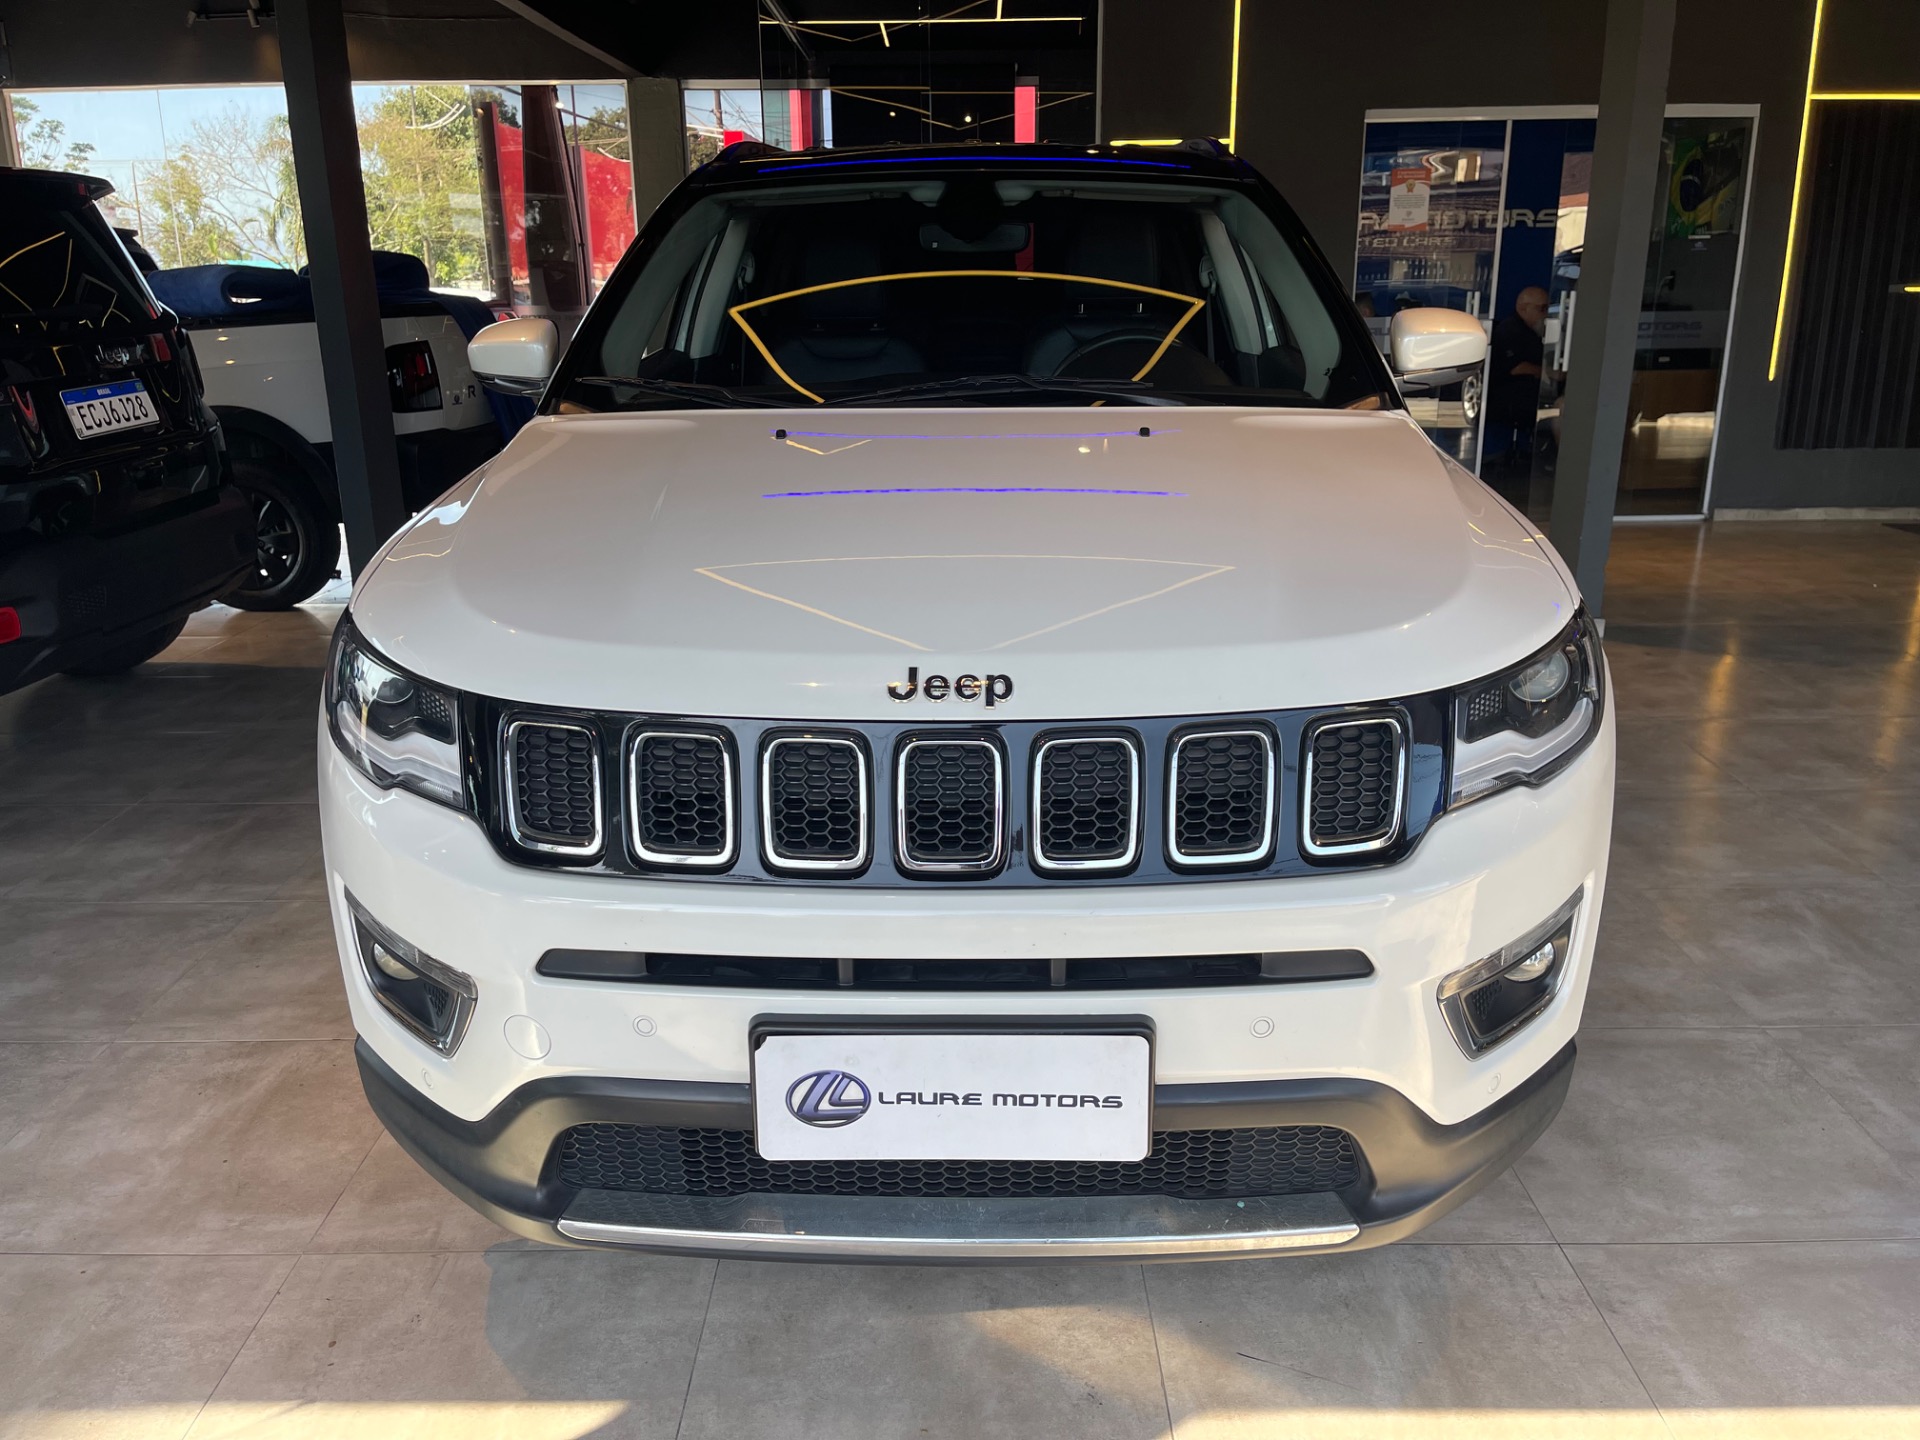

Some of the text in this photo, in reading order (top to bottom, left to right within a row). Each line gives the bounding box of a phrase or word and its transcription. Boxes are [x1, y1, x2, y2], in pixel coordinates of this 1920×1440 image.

[95, 344, 130, 366] Jeep
[76, 395, 149, 431] ECJ6J28
[887, 666, 1014, 709] Jeep
[878, 1091, 1124, 1109] LAURE MOTORS
